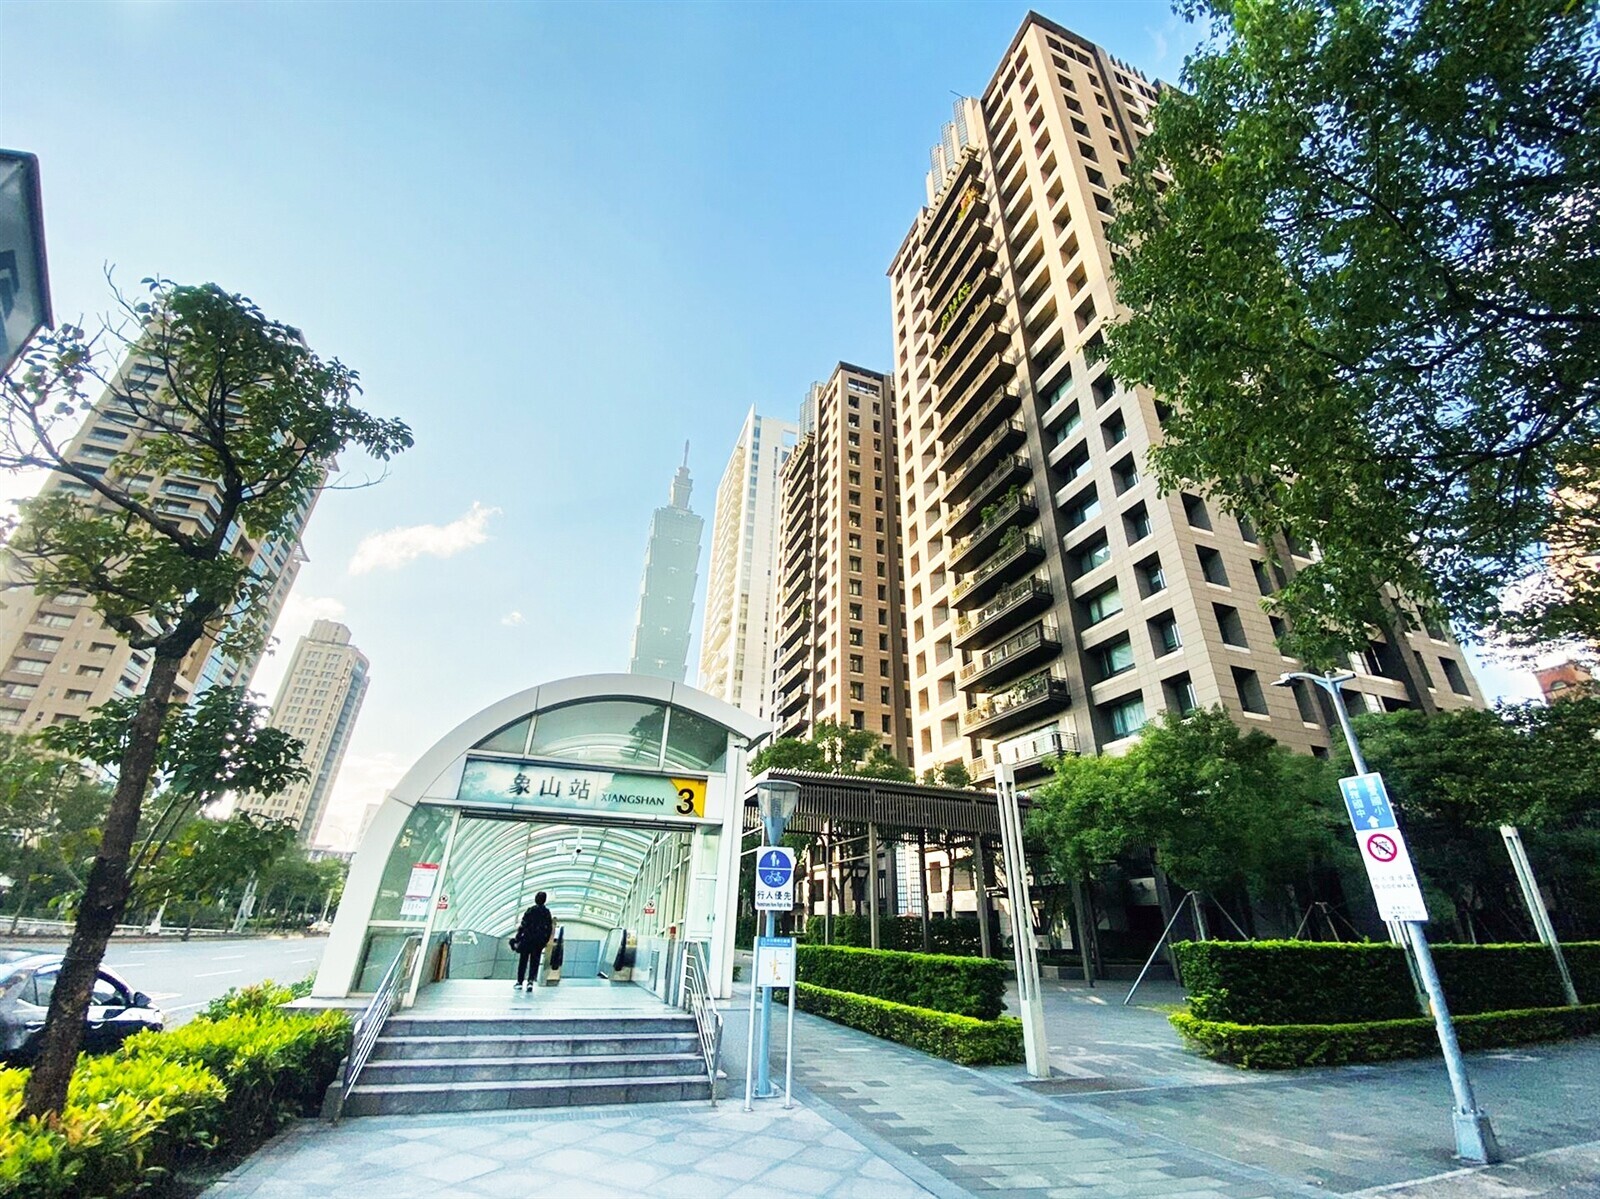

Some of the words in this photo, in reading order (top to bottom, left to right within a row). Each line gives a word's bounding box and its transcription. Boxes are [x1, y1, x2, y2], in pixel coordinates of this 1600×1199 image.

[508, 772, 591, 801] 象山站
[600, 792, 665, 806] XIANGSHAN
[676, 788, 695, 815] 3
[757, 890, 792, 901] 行人優先
